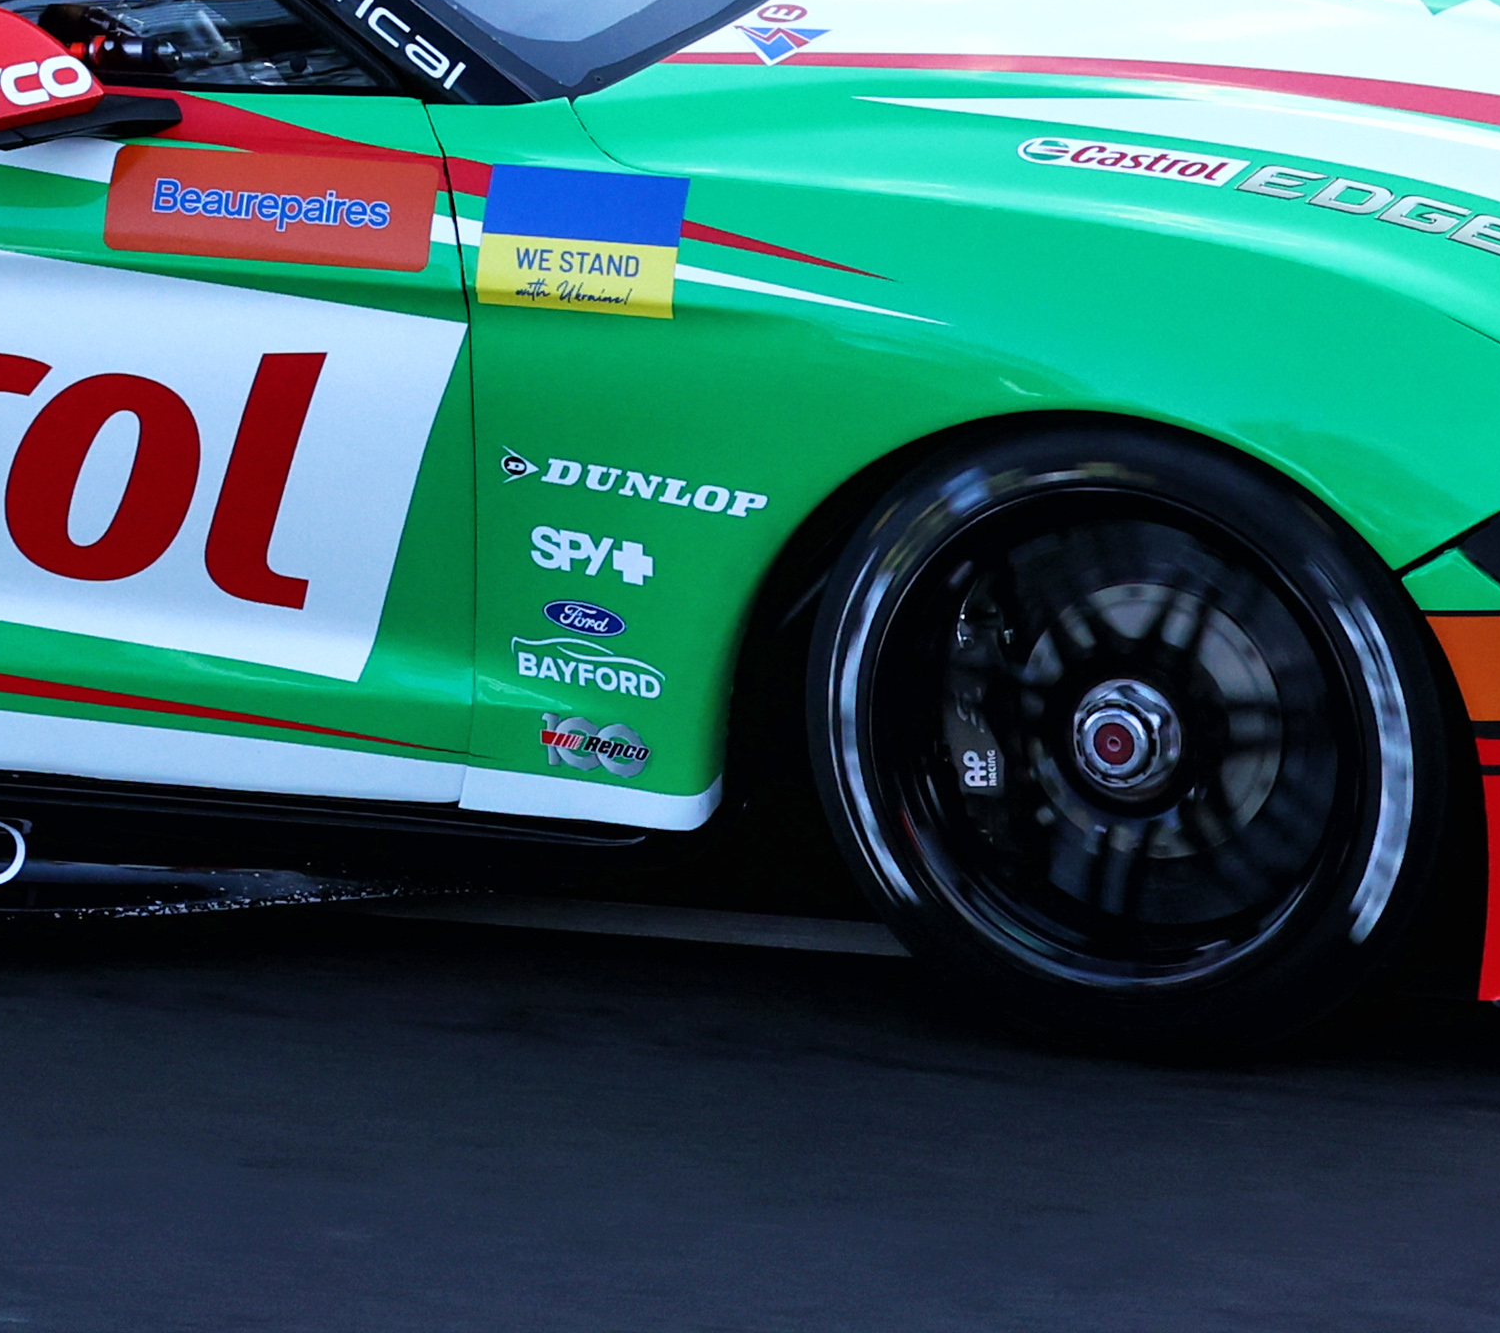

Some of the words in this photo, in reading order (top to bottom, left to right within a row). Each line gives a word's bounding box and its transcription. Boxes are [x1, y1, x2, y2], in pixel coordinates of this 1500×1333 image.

[1069, 145, 1227, 183] Castrol
[152, 179, 391, 232] Beaurepaires
[516, 247, 553, 272] WE
[561, 251, 640, 279] STAND
[515, 280, 551, 303] with
[541, 458, 768, 517] DUNLOP
[559, 602, 610, 632] Ford
[518, 651, 661, 699] BAYFORD
[584, 736, 650, 762] Repco
